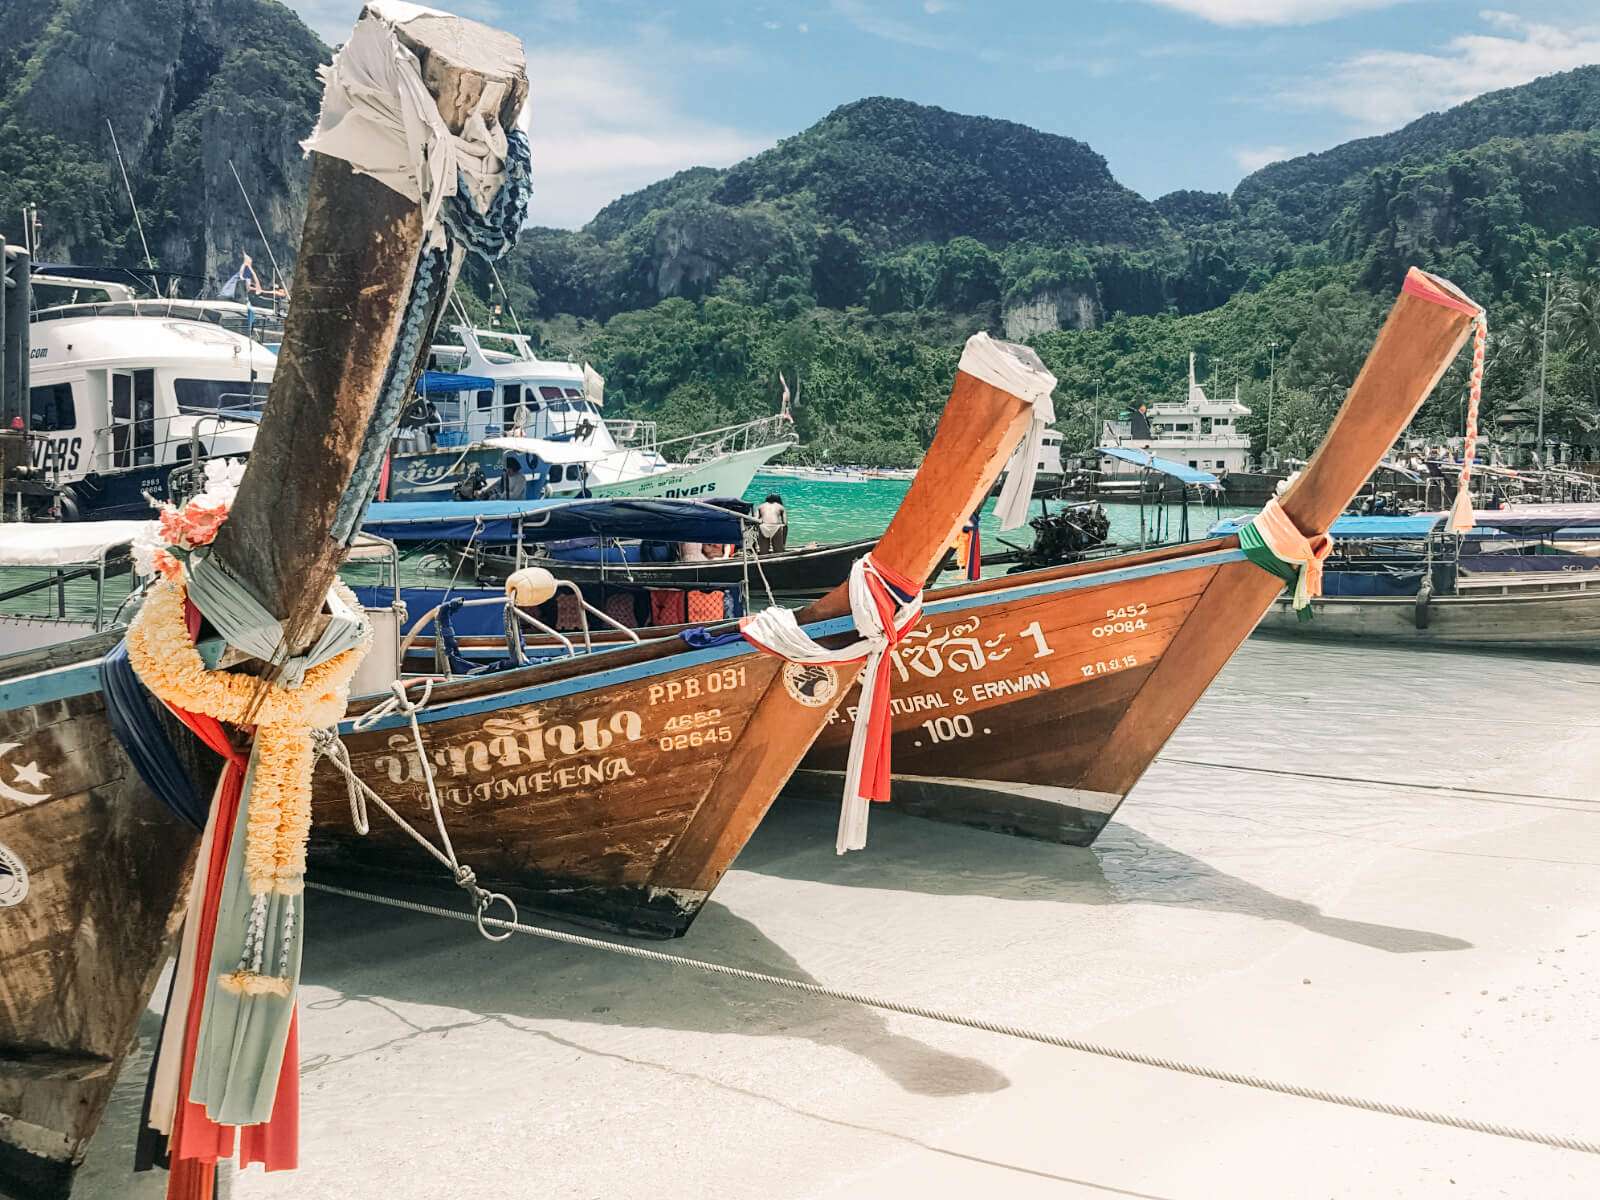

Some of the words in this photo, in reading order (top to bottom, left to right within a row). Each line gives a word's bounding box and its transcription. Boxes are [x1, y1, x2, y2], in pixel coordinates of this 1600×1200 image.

[1106, 603, 1149, 621] 5452
[1092, 618, 1148, 638] 09084
[971, 671, 1051, 702] ERAWAN
[664, 708, 722, 731] 4652
[660, 726, 732, 752] 02645
